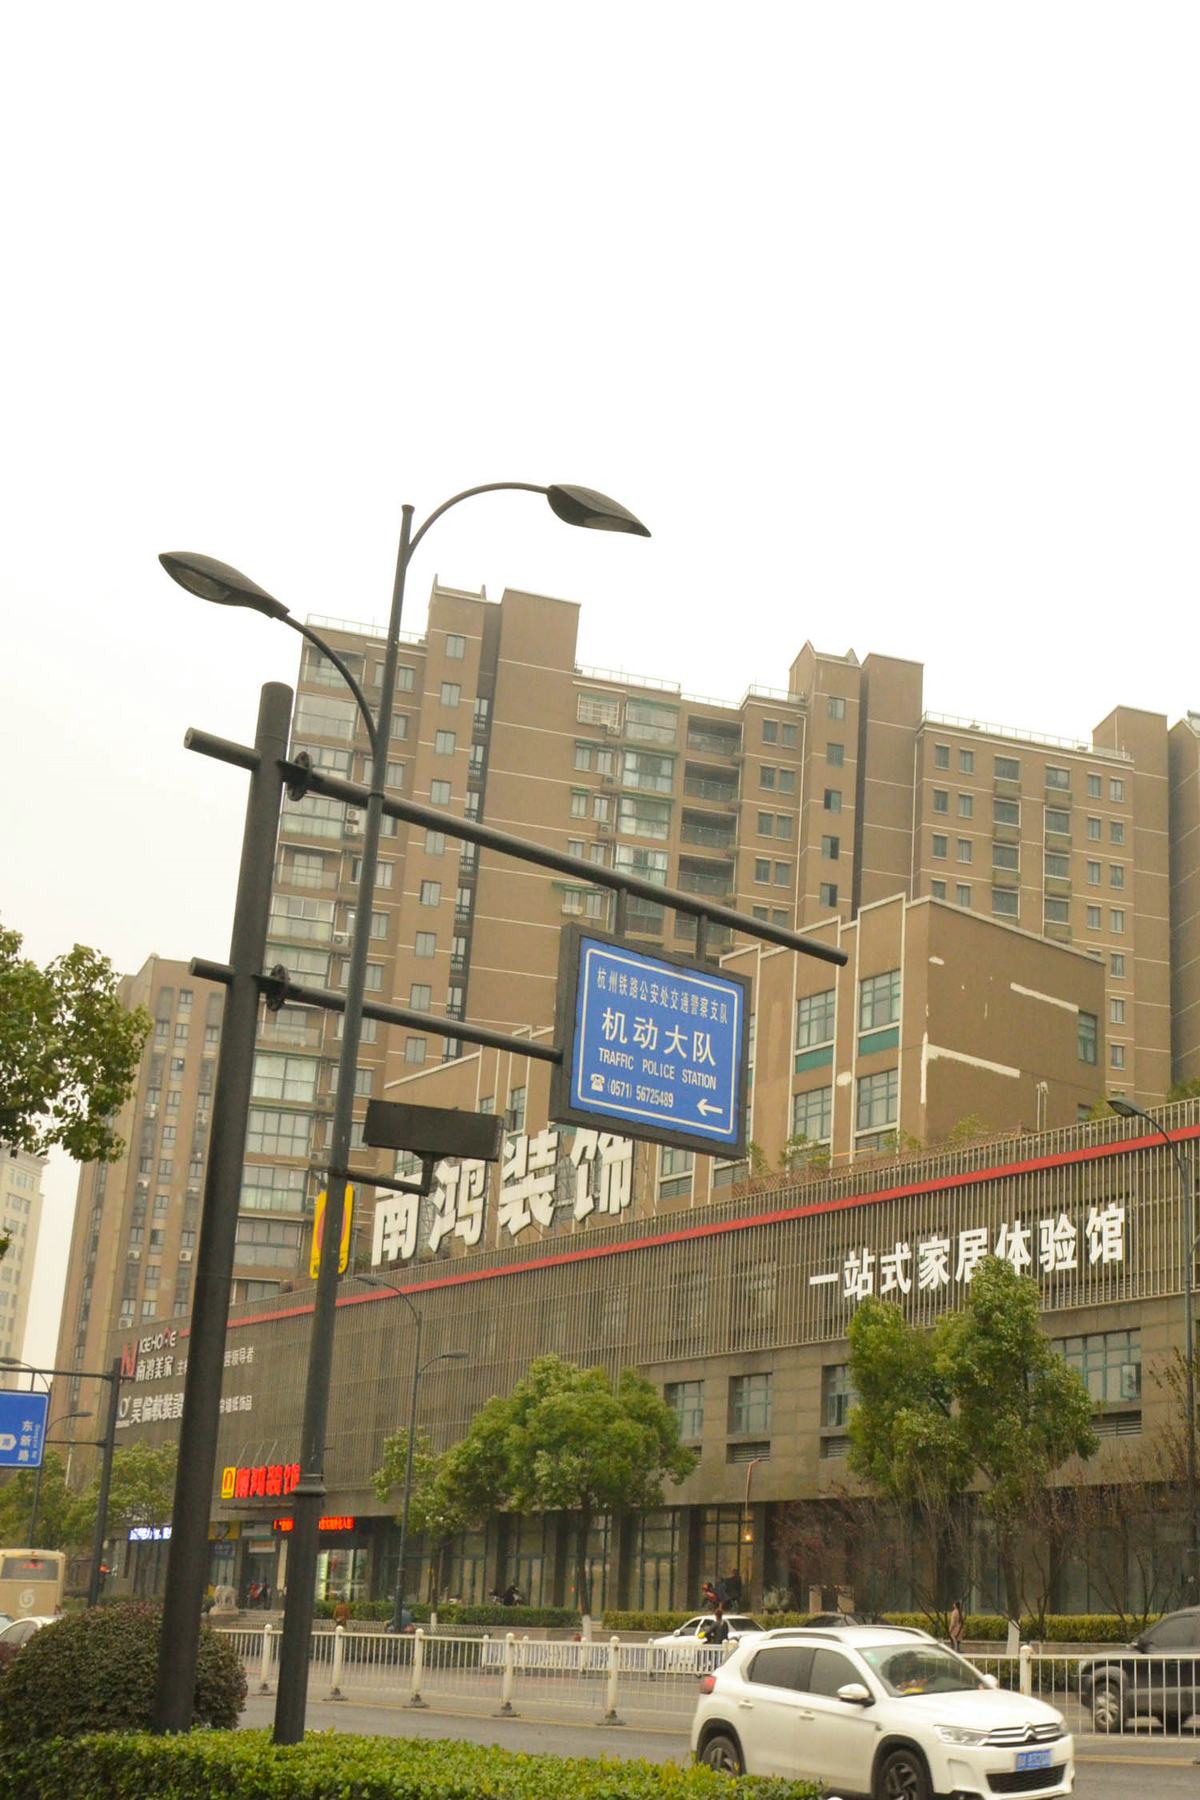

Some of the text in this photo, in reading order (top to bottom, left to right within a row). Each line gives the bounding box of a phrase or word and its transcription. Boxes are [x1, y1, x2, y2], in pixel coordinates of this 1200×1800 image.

[597, 967, 728, 1025] 杭州铁路公安处交通警察支队
[602, 1007, 716, 1067] 机动大队
[598, 1047, 717, 1091] TRAFFIC POLICE STATION
[636, 1084, 674, 1108] 56725489
[371, 1128, 633, 1266] 南鸿装饰
[809, 1203, 1125, 1300] 一站式家居体验馆
